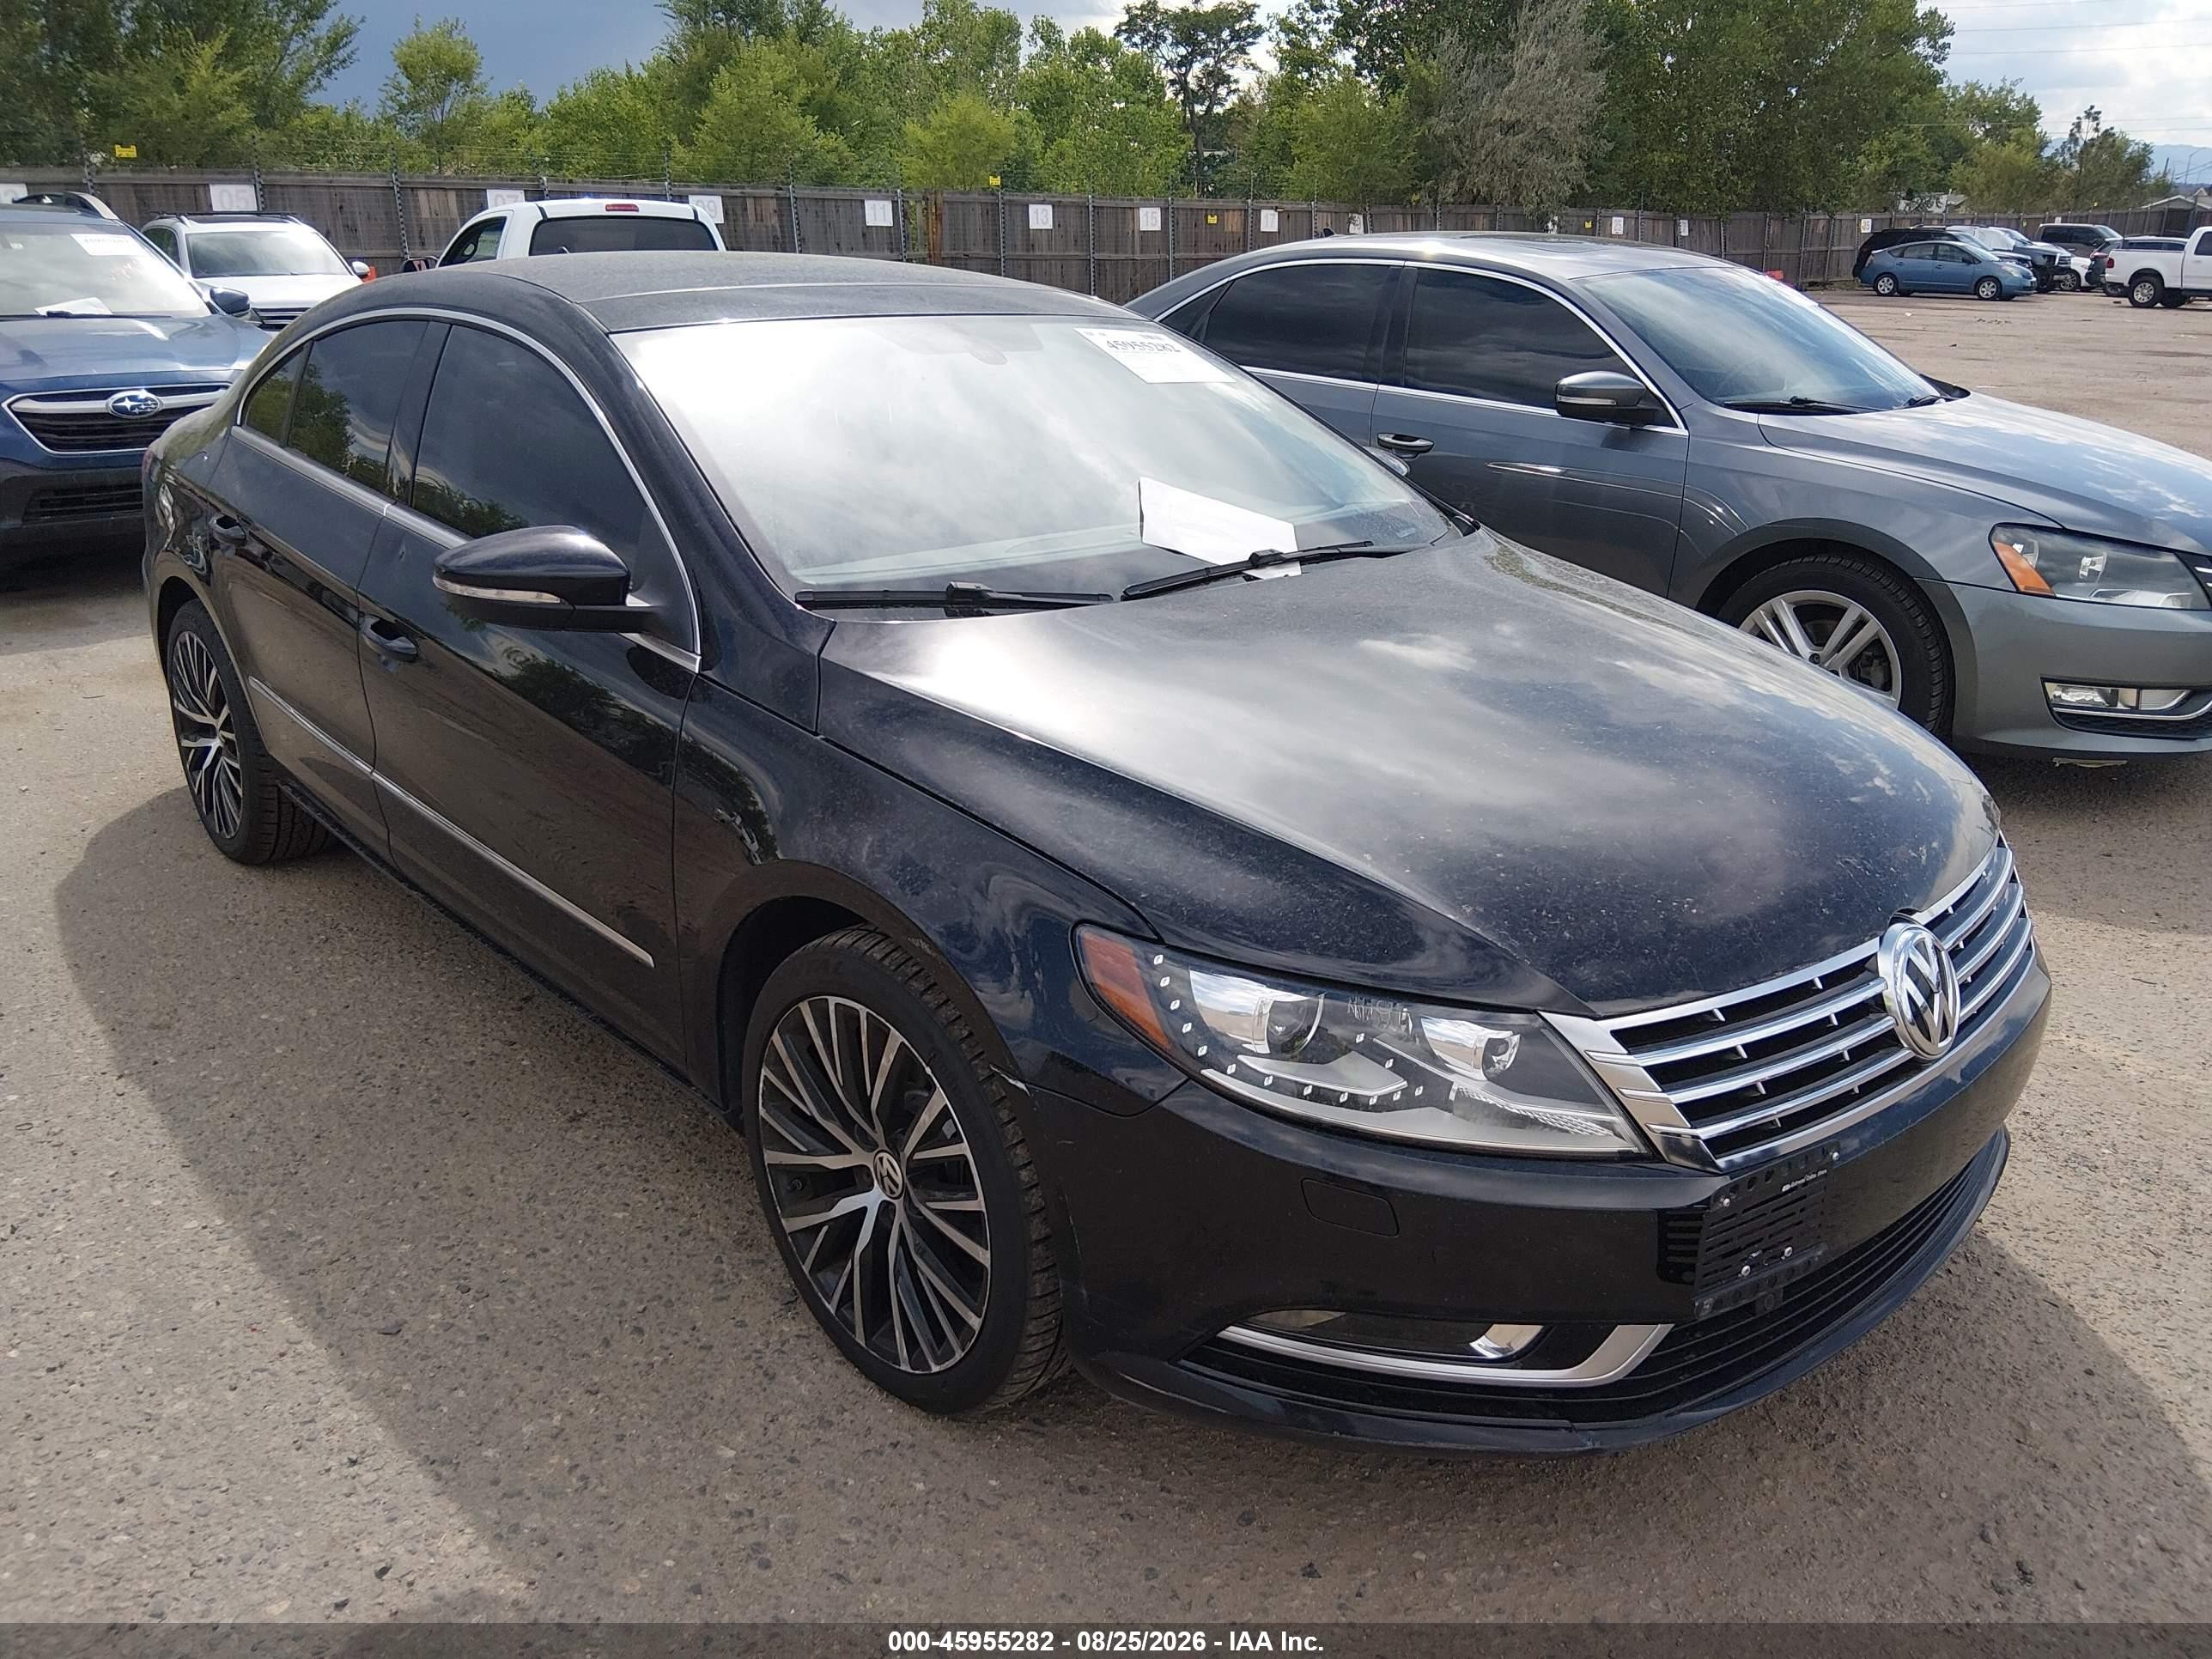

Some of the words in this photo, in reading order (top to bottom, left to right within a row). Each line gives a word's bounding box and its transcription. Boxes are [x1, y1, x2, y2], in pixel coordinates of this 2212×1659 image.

[219, 188, 250, 209] 05
[870, 204, 887, 221] 11
[1034, 209, 1048, 225] 13
[1143, 210, 1157, 228] 15
[1264, 213, 1276, 227] 17
